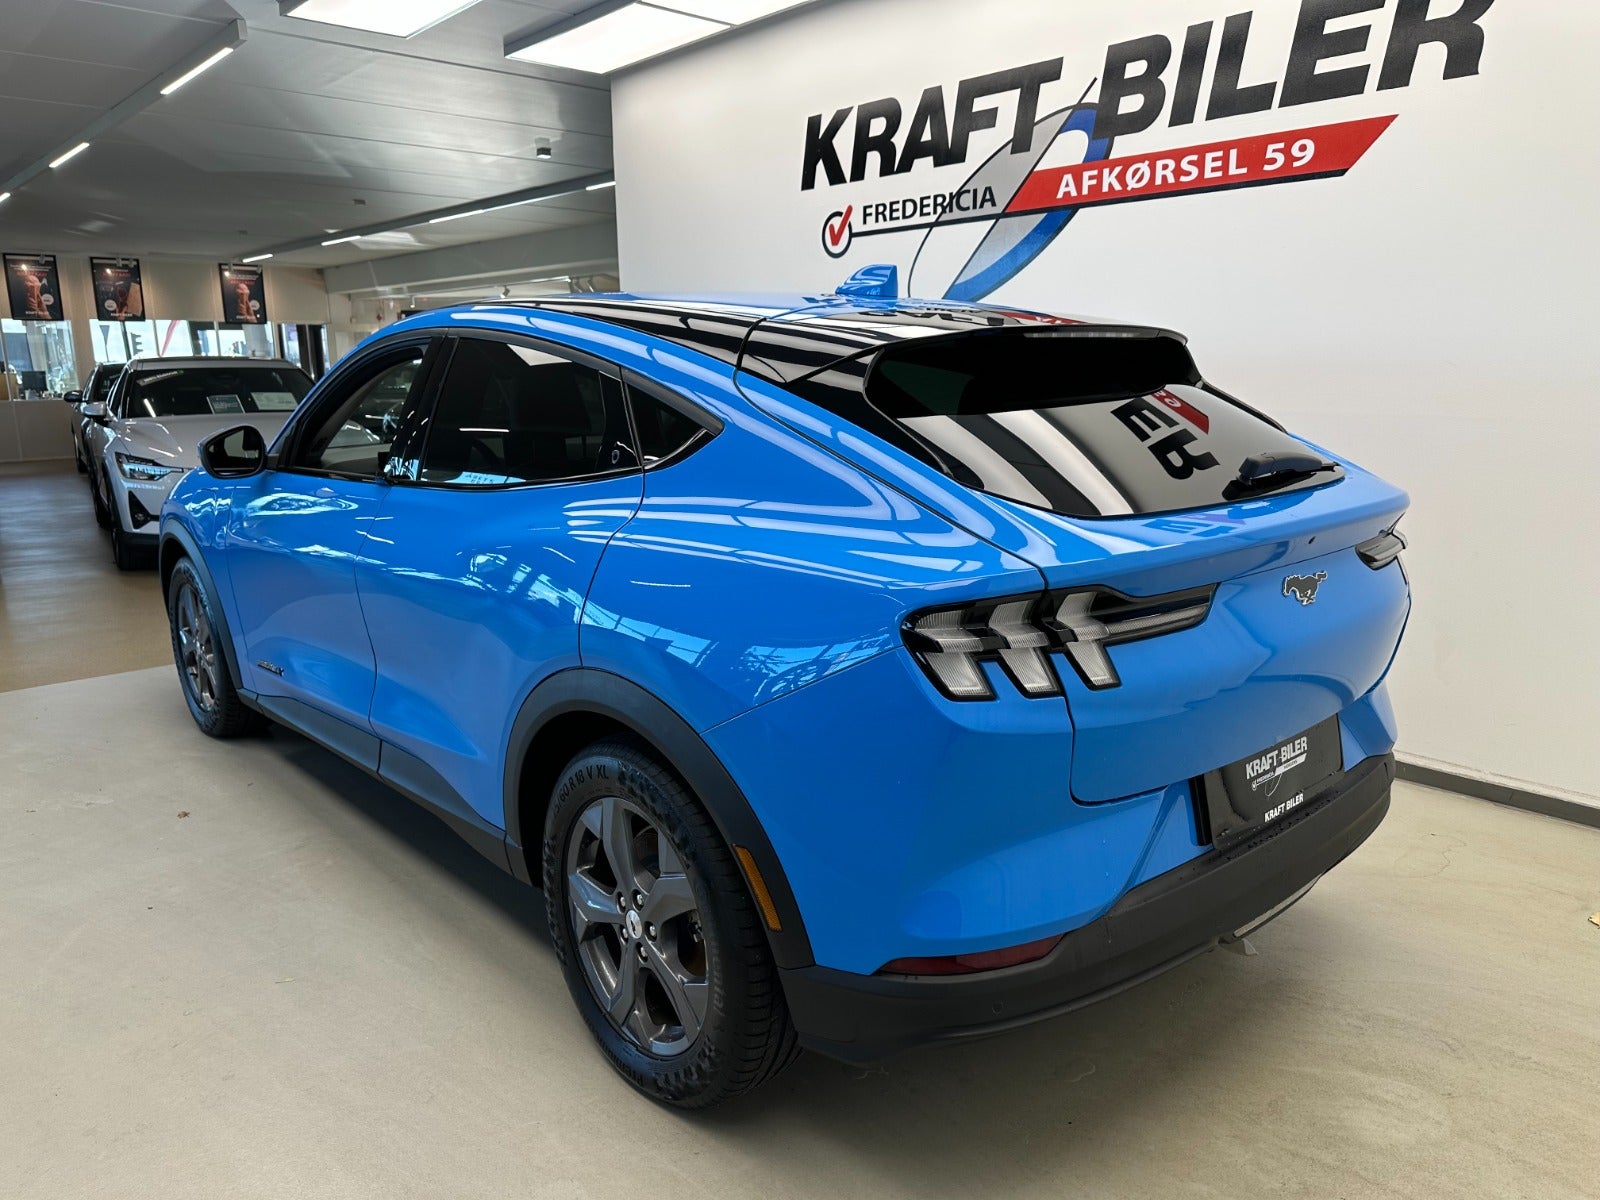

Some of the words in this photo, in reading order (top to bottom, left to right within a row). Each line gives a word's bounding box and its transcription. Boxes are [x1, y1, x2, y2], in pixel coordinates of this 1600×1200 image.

[801, 56, 1064, 191] KRAFT
[1091, 0, 1496, 140] BILER
[1056, 149, 1248, 199] AFKØRSEL
[1263, 138, 1316, 171] 59
[862, 186, 997, 225] FREDERICIA
[1246, 751, 1278, 779] KRAFT
[1281, 737, 1307, 762] BILER
[1265, 803, 1285, 822] KRAFT
[1286, 794, 1303, 810] BILER
